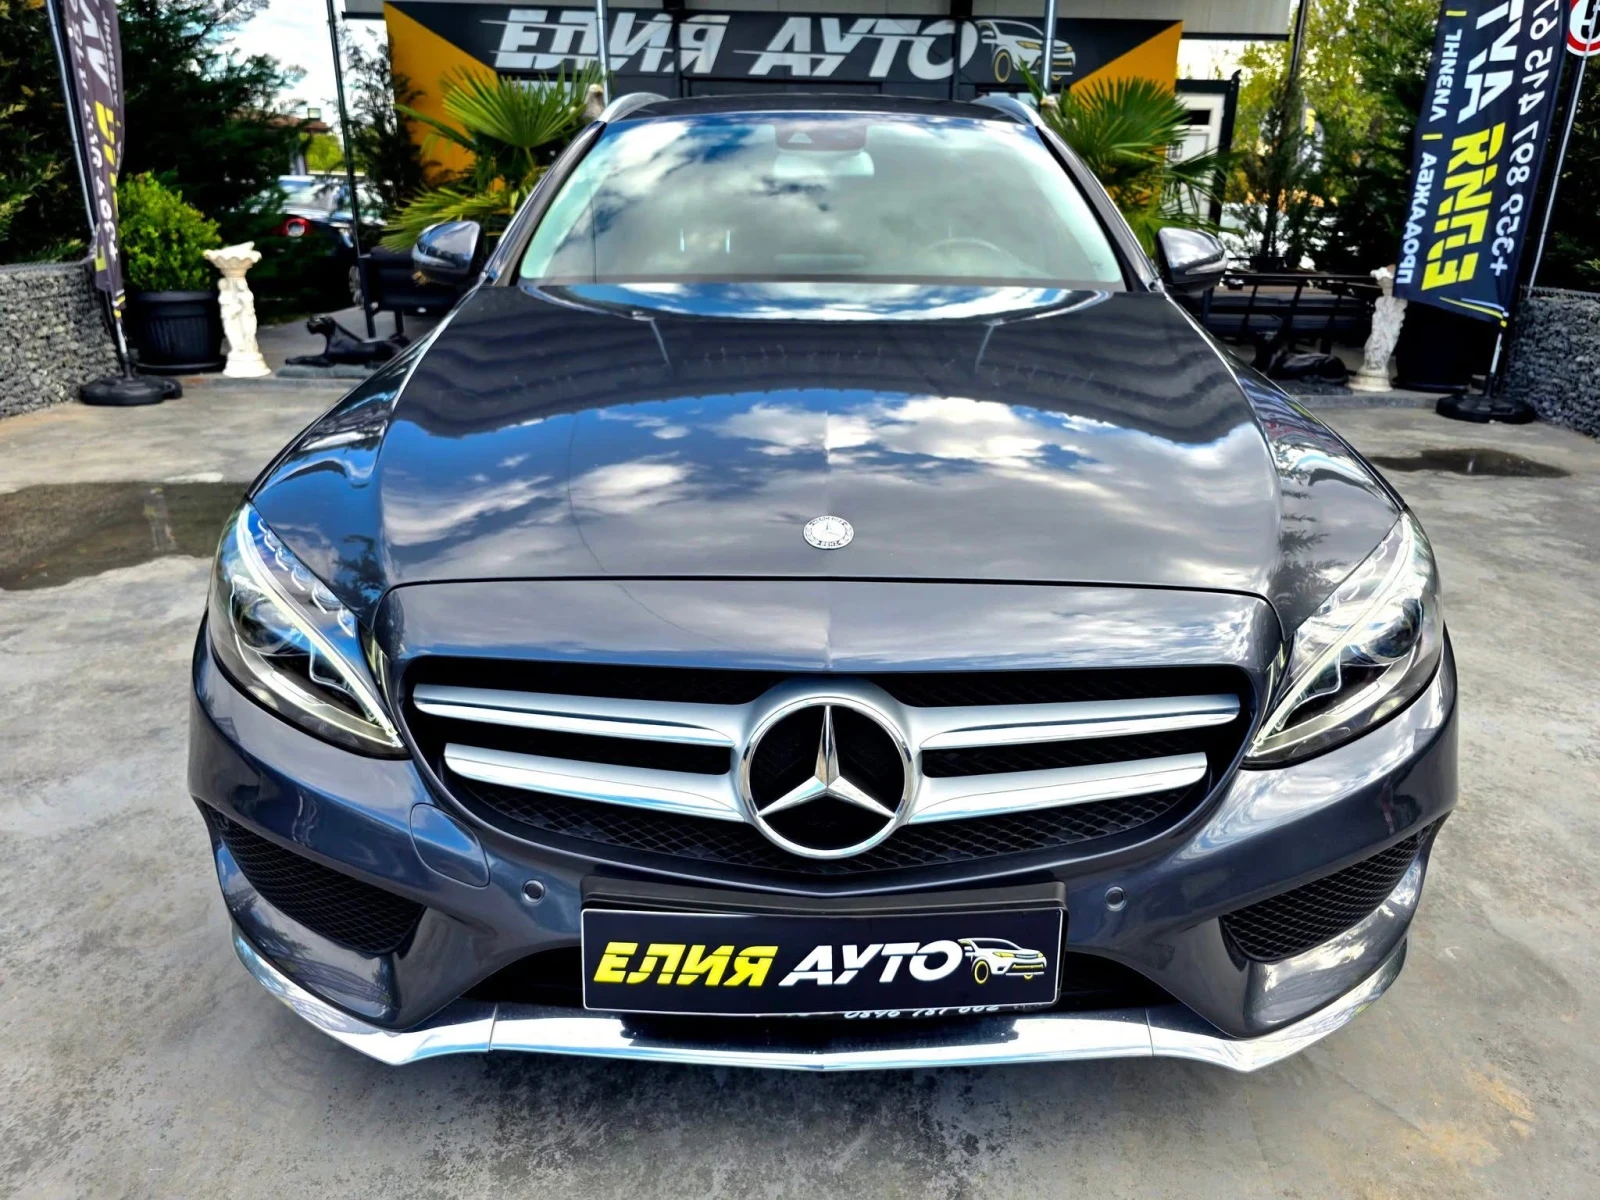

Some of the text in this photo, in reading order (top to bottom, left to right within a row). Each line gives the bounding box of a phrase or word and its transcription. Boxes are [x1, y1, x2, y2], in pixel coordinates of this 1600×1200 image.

[494, 8, 979, 81] ЕЛИЯ АУТО
[593, 940, 963, 987] ЕЛИЯ АУТО
